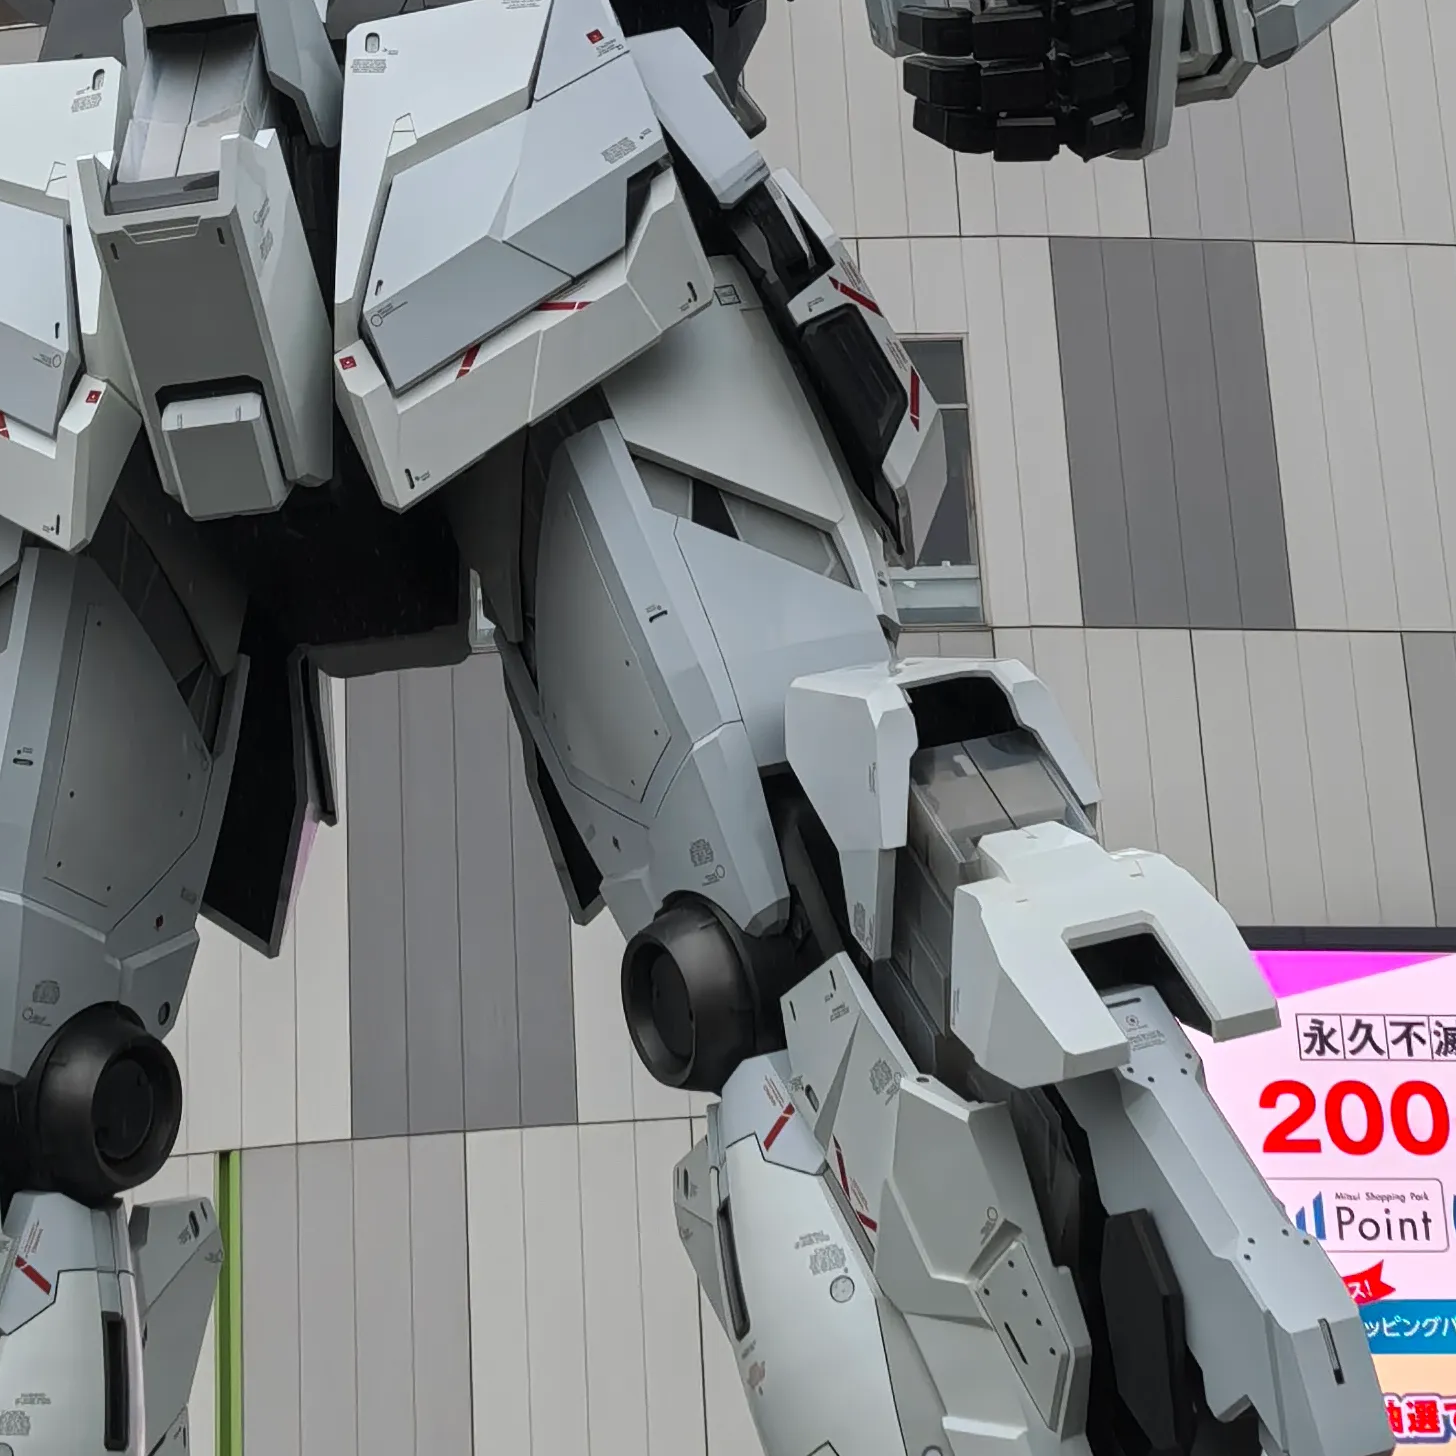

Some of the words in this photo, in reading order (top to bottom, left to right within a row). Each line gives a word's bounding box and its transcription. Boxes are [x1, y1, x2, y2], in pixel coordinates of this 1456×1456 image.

[1365, 1191, 1406, 1205] Shopping
[1409, 1191, 1430, 1202] Park
[1336, 1206, 1433, 1242] Point
